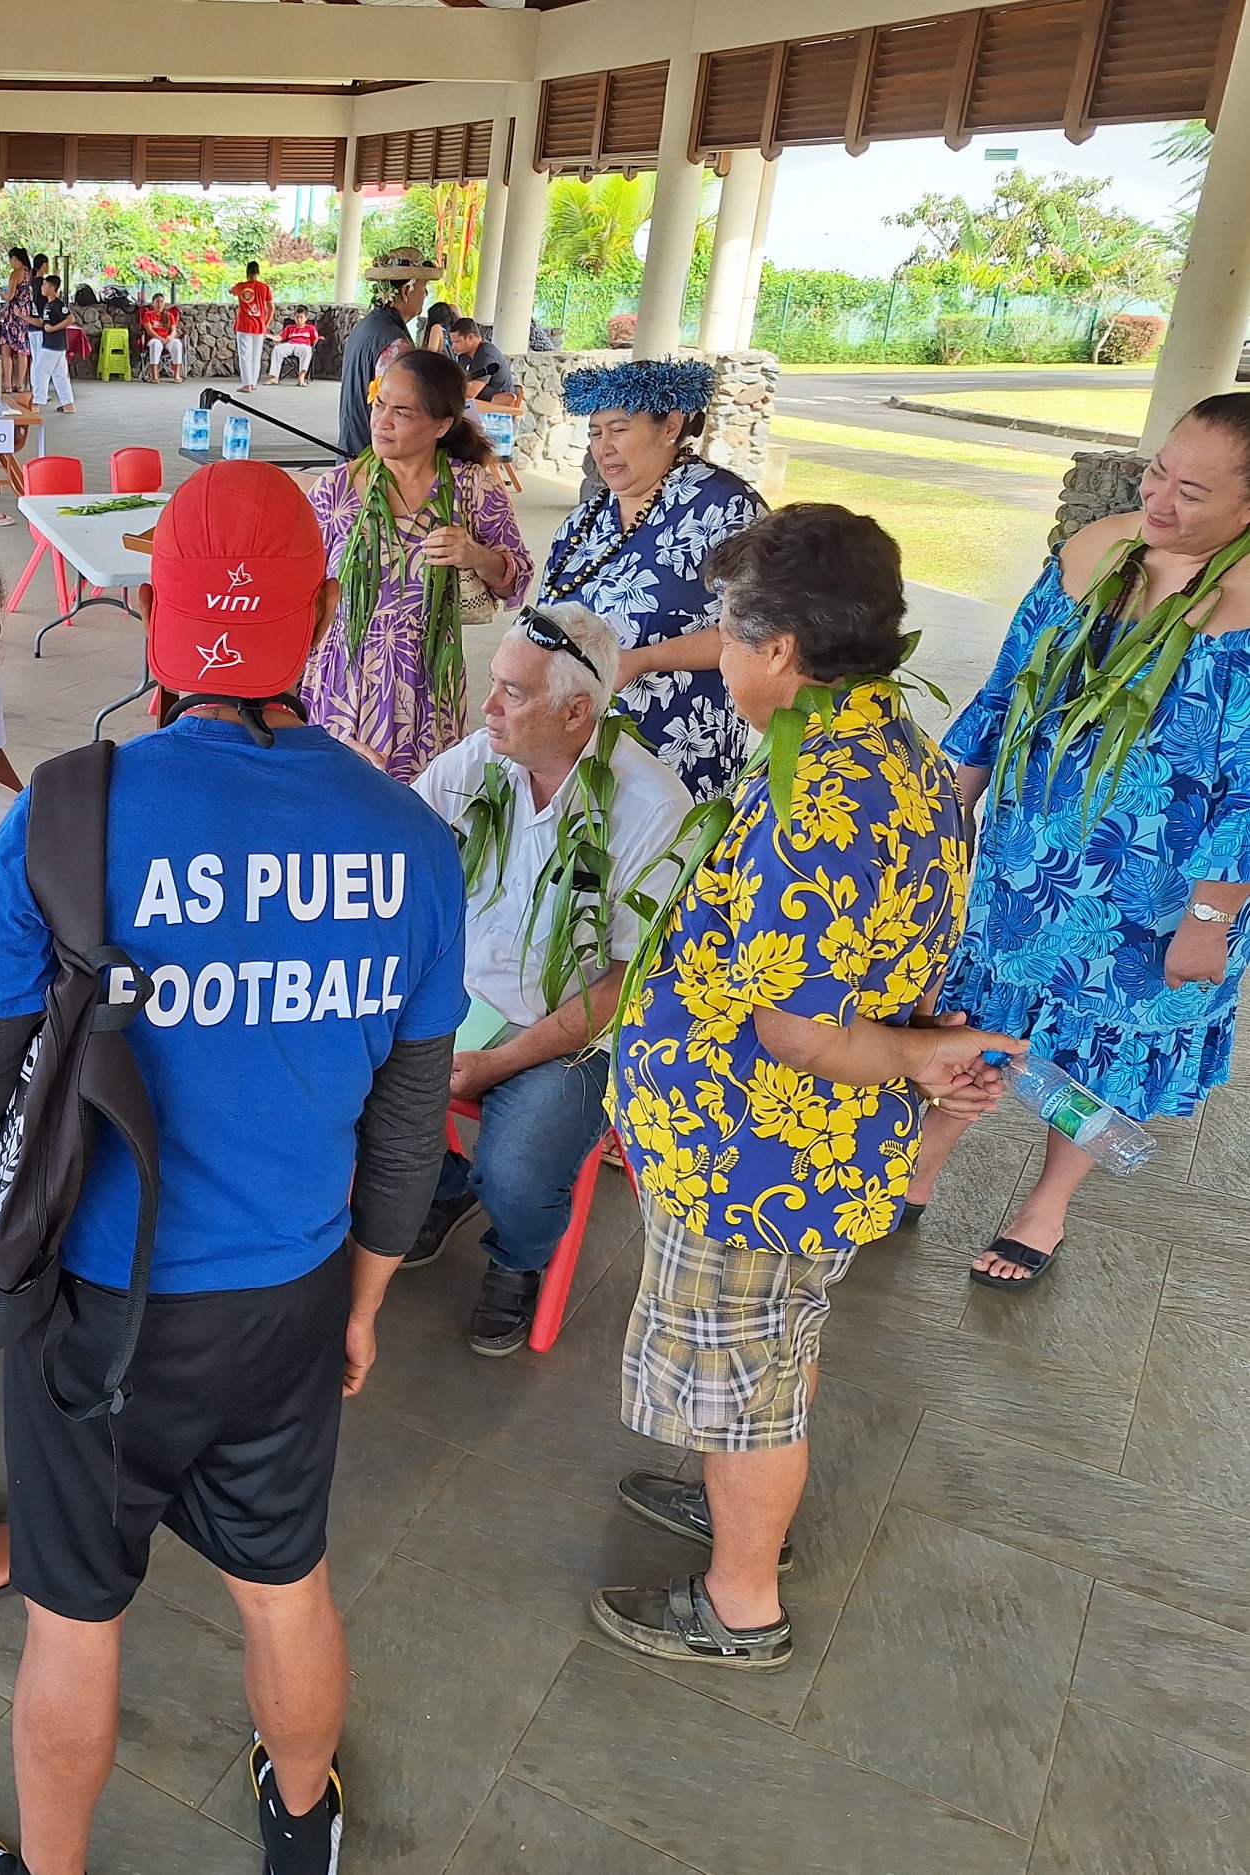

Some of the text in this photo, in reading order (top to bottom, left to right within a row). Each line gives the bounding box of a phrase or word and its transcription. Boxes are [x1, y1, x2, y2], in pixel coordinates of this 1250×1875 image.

[133, 852, 406, 928] AS PUEU
[108, 955, 403, 1028] FOOTBALL
